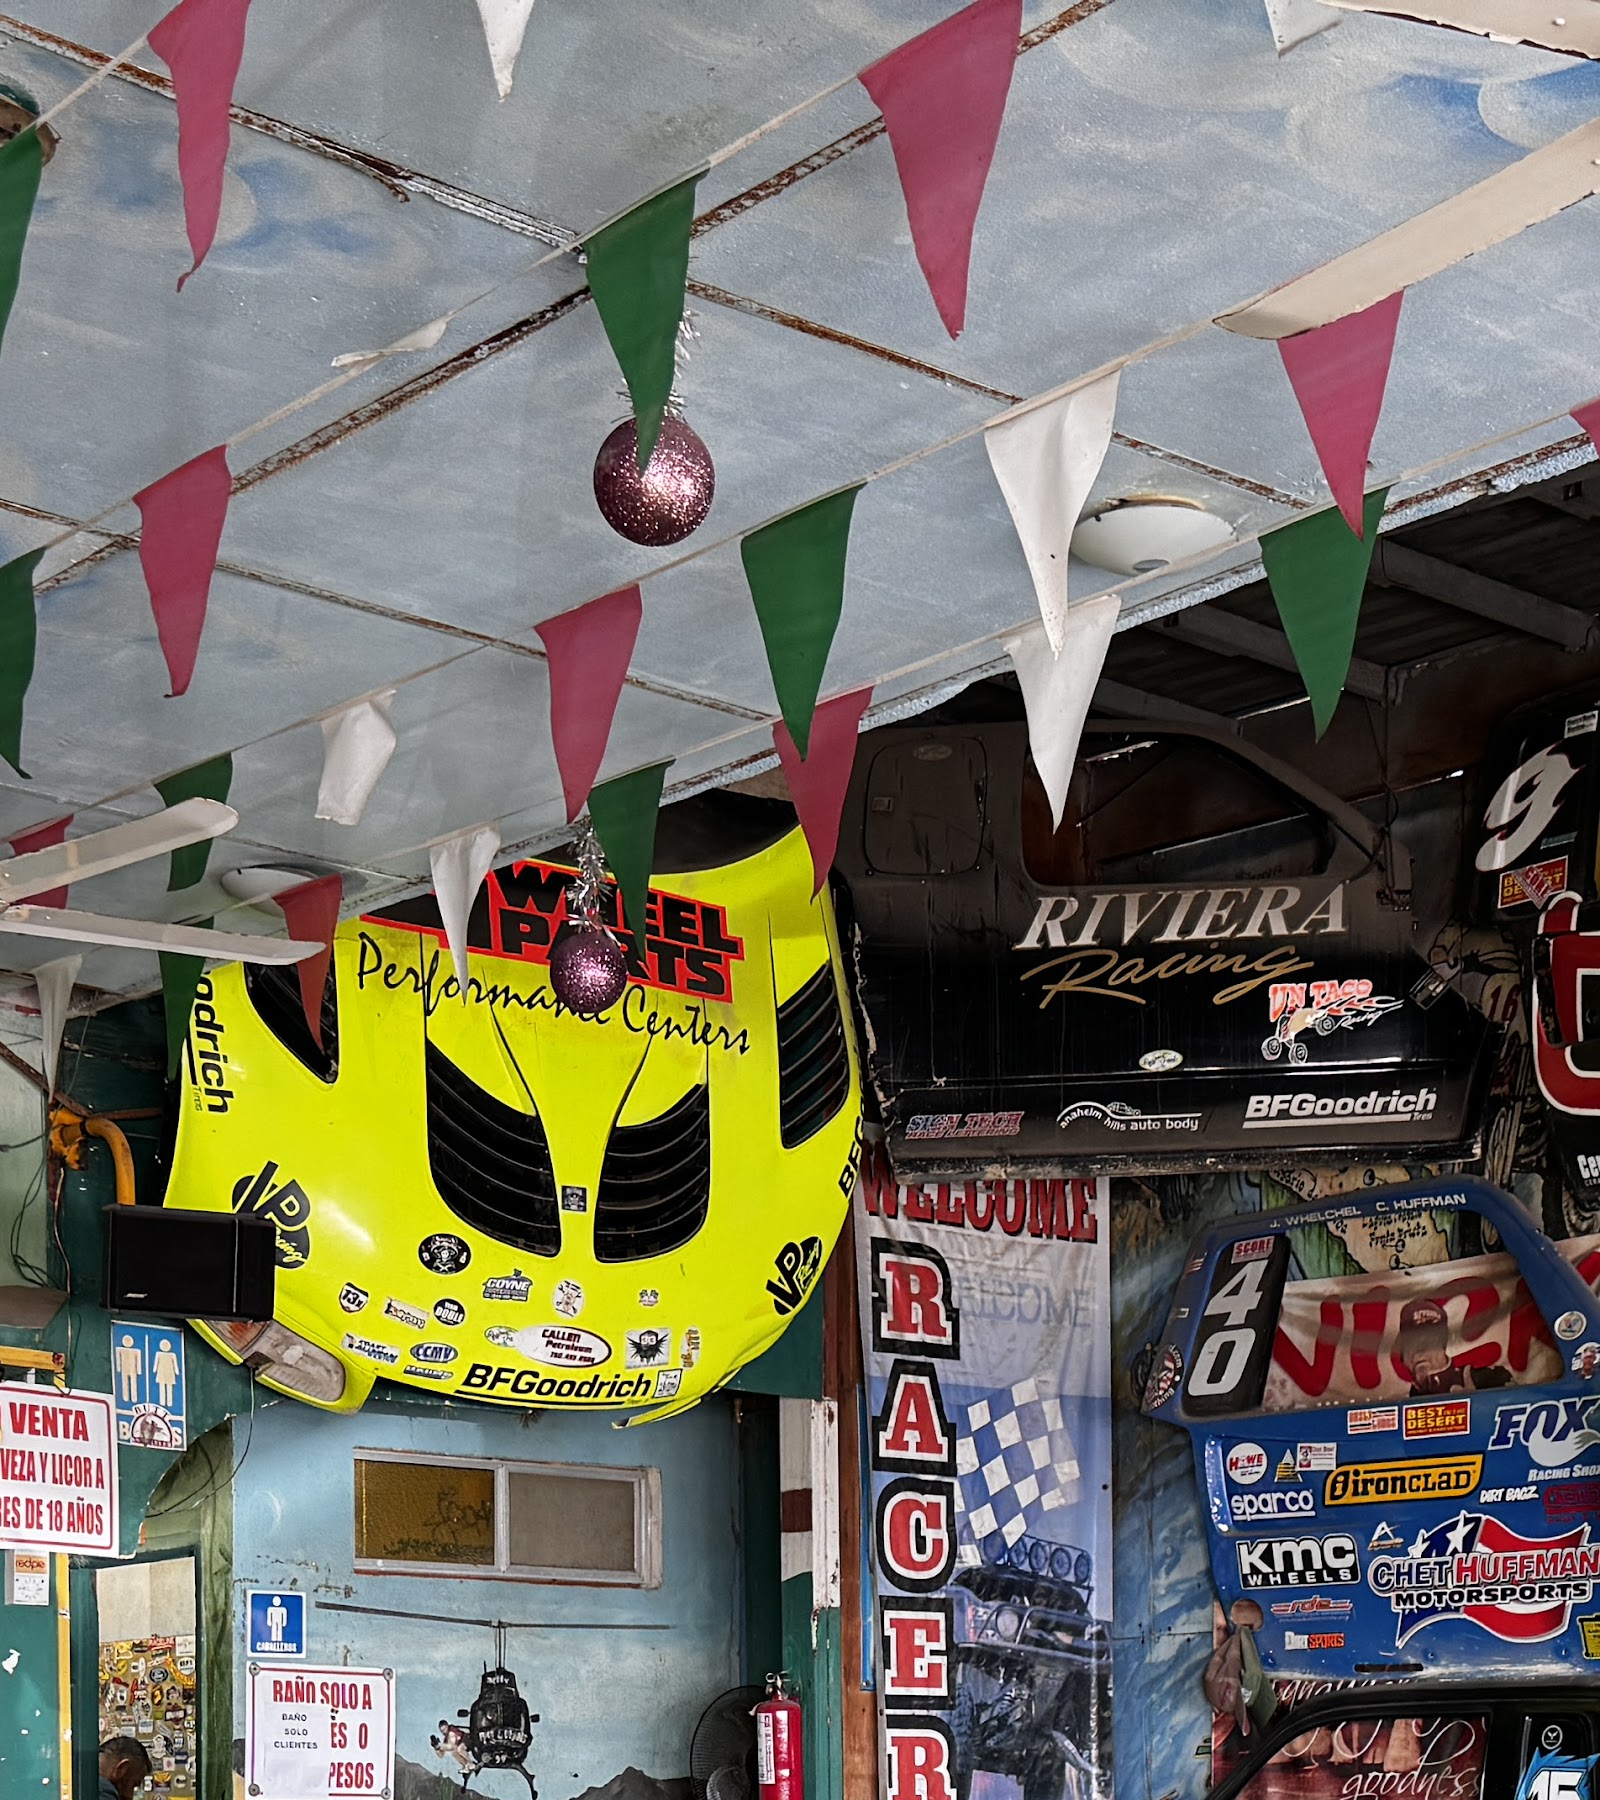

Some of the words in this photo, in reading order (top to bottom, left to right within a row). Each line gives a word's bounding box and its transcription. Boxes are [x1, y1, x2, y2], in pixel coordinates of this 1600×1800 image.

[1012, 883, 1350, 949] RIVIERA
[1020, 942, 1315, 1010] Racing
[1269, 983, 1306, 1022] UN
[1311, 979, 1373, 1010] TACO
[623, 986, 750, 1056] Centers
[1245, 1088, 1438, 1119] BFGoodrich
[1061, 1107, 1103, 1129] anaheim
[1103, 1117, 1127, 1132] hills
[1130, 1119, 1161, 1131] auto
[1166, 1116, 1199, 1132] body
[858, 1140, 1098, 1243] WELCOME
[1286, 1206, 1362, 1225] WHELCHEL
[1376, 1202, 1389, 1212] C.
[1394, 1193, 1467, 1210] HUFFMAN
[1235, 1238, 1272, 1255] SCORE
[486, 1278, 529, 1291] COYNE
[462, 1363, 652, 1399] BFGoodrich
[9, 1402, 89, 1442] VENTA
[1407, 1406, 1445, 1420] BEST
[1407, 1414, 1467, 1430] DESERT
[39, 1452, 48, 1483] Y
[51, 1453, 92, 1488] LICOR
[96, 1458, 105, 1489] A
[1528, 1467, 1570, 1482] RACING
[1231, 1490, 1313, 1521] sparco
[1480, 1488, 1502, 1503] DIRT
[25, 1497, 43, 1530] DE
[46, 1499, 63, 1532] 18
[67, 1496, 103, 1536] AÑOS
[1248, 1569, 1351, 1587] WHEELS
[1373, 1555, 1452, 1590] CHET
[1394, 1582, 1588, 1609] MOTORSPORTS
[320, 1681, 359, 1710] SOLO
[362, 1684, 373, 1710] A
[282, 1711, 307, 1722] BAÑO
[274, 1740, 318, 1749] CLIENTES
[284, 1728, 308, 1736] SOLO
[329, 1762, 374, 1790] PESOS
